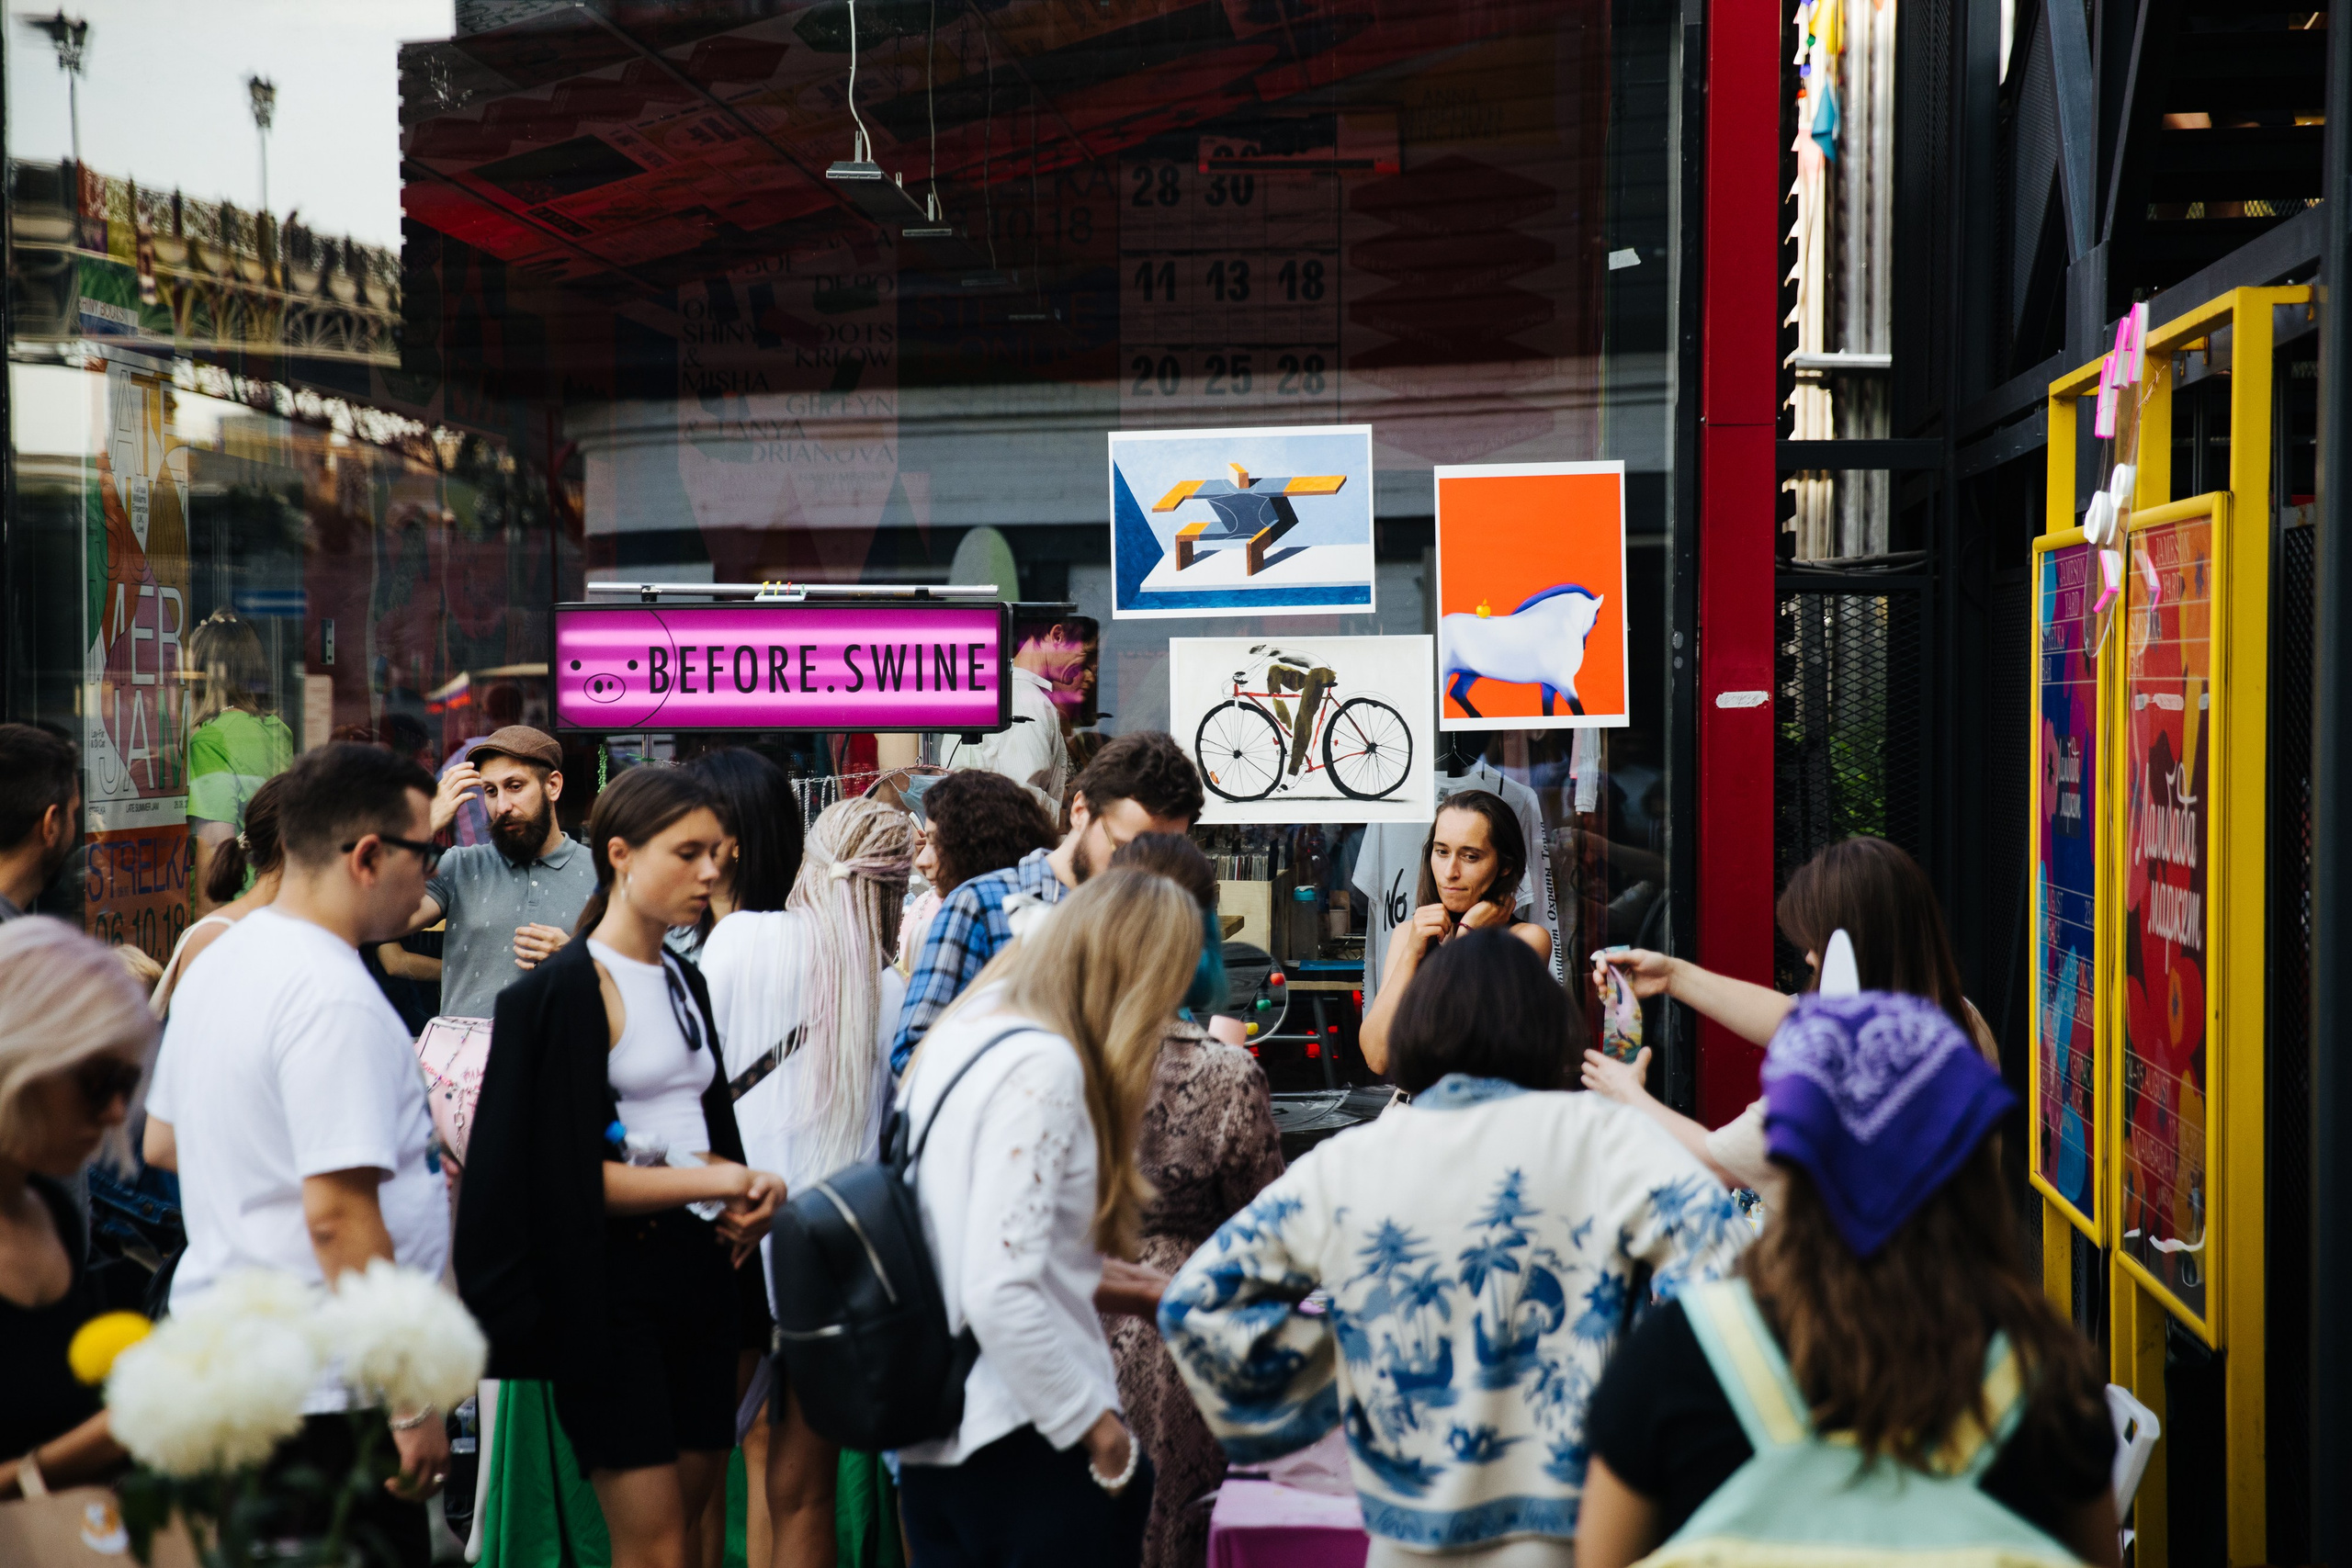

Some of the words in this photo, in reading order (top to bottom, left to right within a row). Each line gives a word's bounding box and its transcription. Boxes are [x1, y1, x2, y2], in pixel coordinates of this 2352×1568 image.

[1132, 165, 1181, 207] 28
[1204, 174, 1254, 207] 30
[1135, 261, 1176, 301] 11
[1206, 260, 1250, 302] 13
[1278, 259, 1325, 301] 18
[683, 347, 702, 368] &
[1131, 355, 1181, 396] 20
[1204, 355, 1252, 395] 25
[1277, 354, 1326, 395] 28
[683, 371, 770, 392] MISHA
[2155, 532, 2189, 567] JAMESON
[2059, 557, 2085, 587] JAMESON
[2163, 572, 2183, 604] YARD
[2064, 591, 2080, 618] YARD
[86, 581, 185, 686] MER
[649, 643, 987, 694] BEFORE.SWINE
[98, 687, 190, 796] JAM
[2134, 761, 2198, 869] Ламбада
[88, 836, 191, 901] STRELKA
[1544, 868, 1556, 921] Охраны
[2148, 880, 2201, 975] маркет
[1552, 929, 1564, 987] омитет
